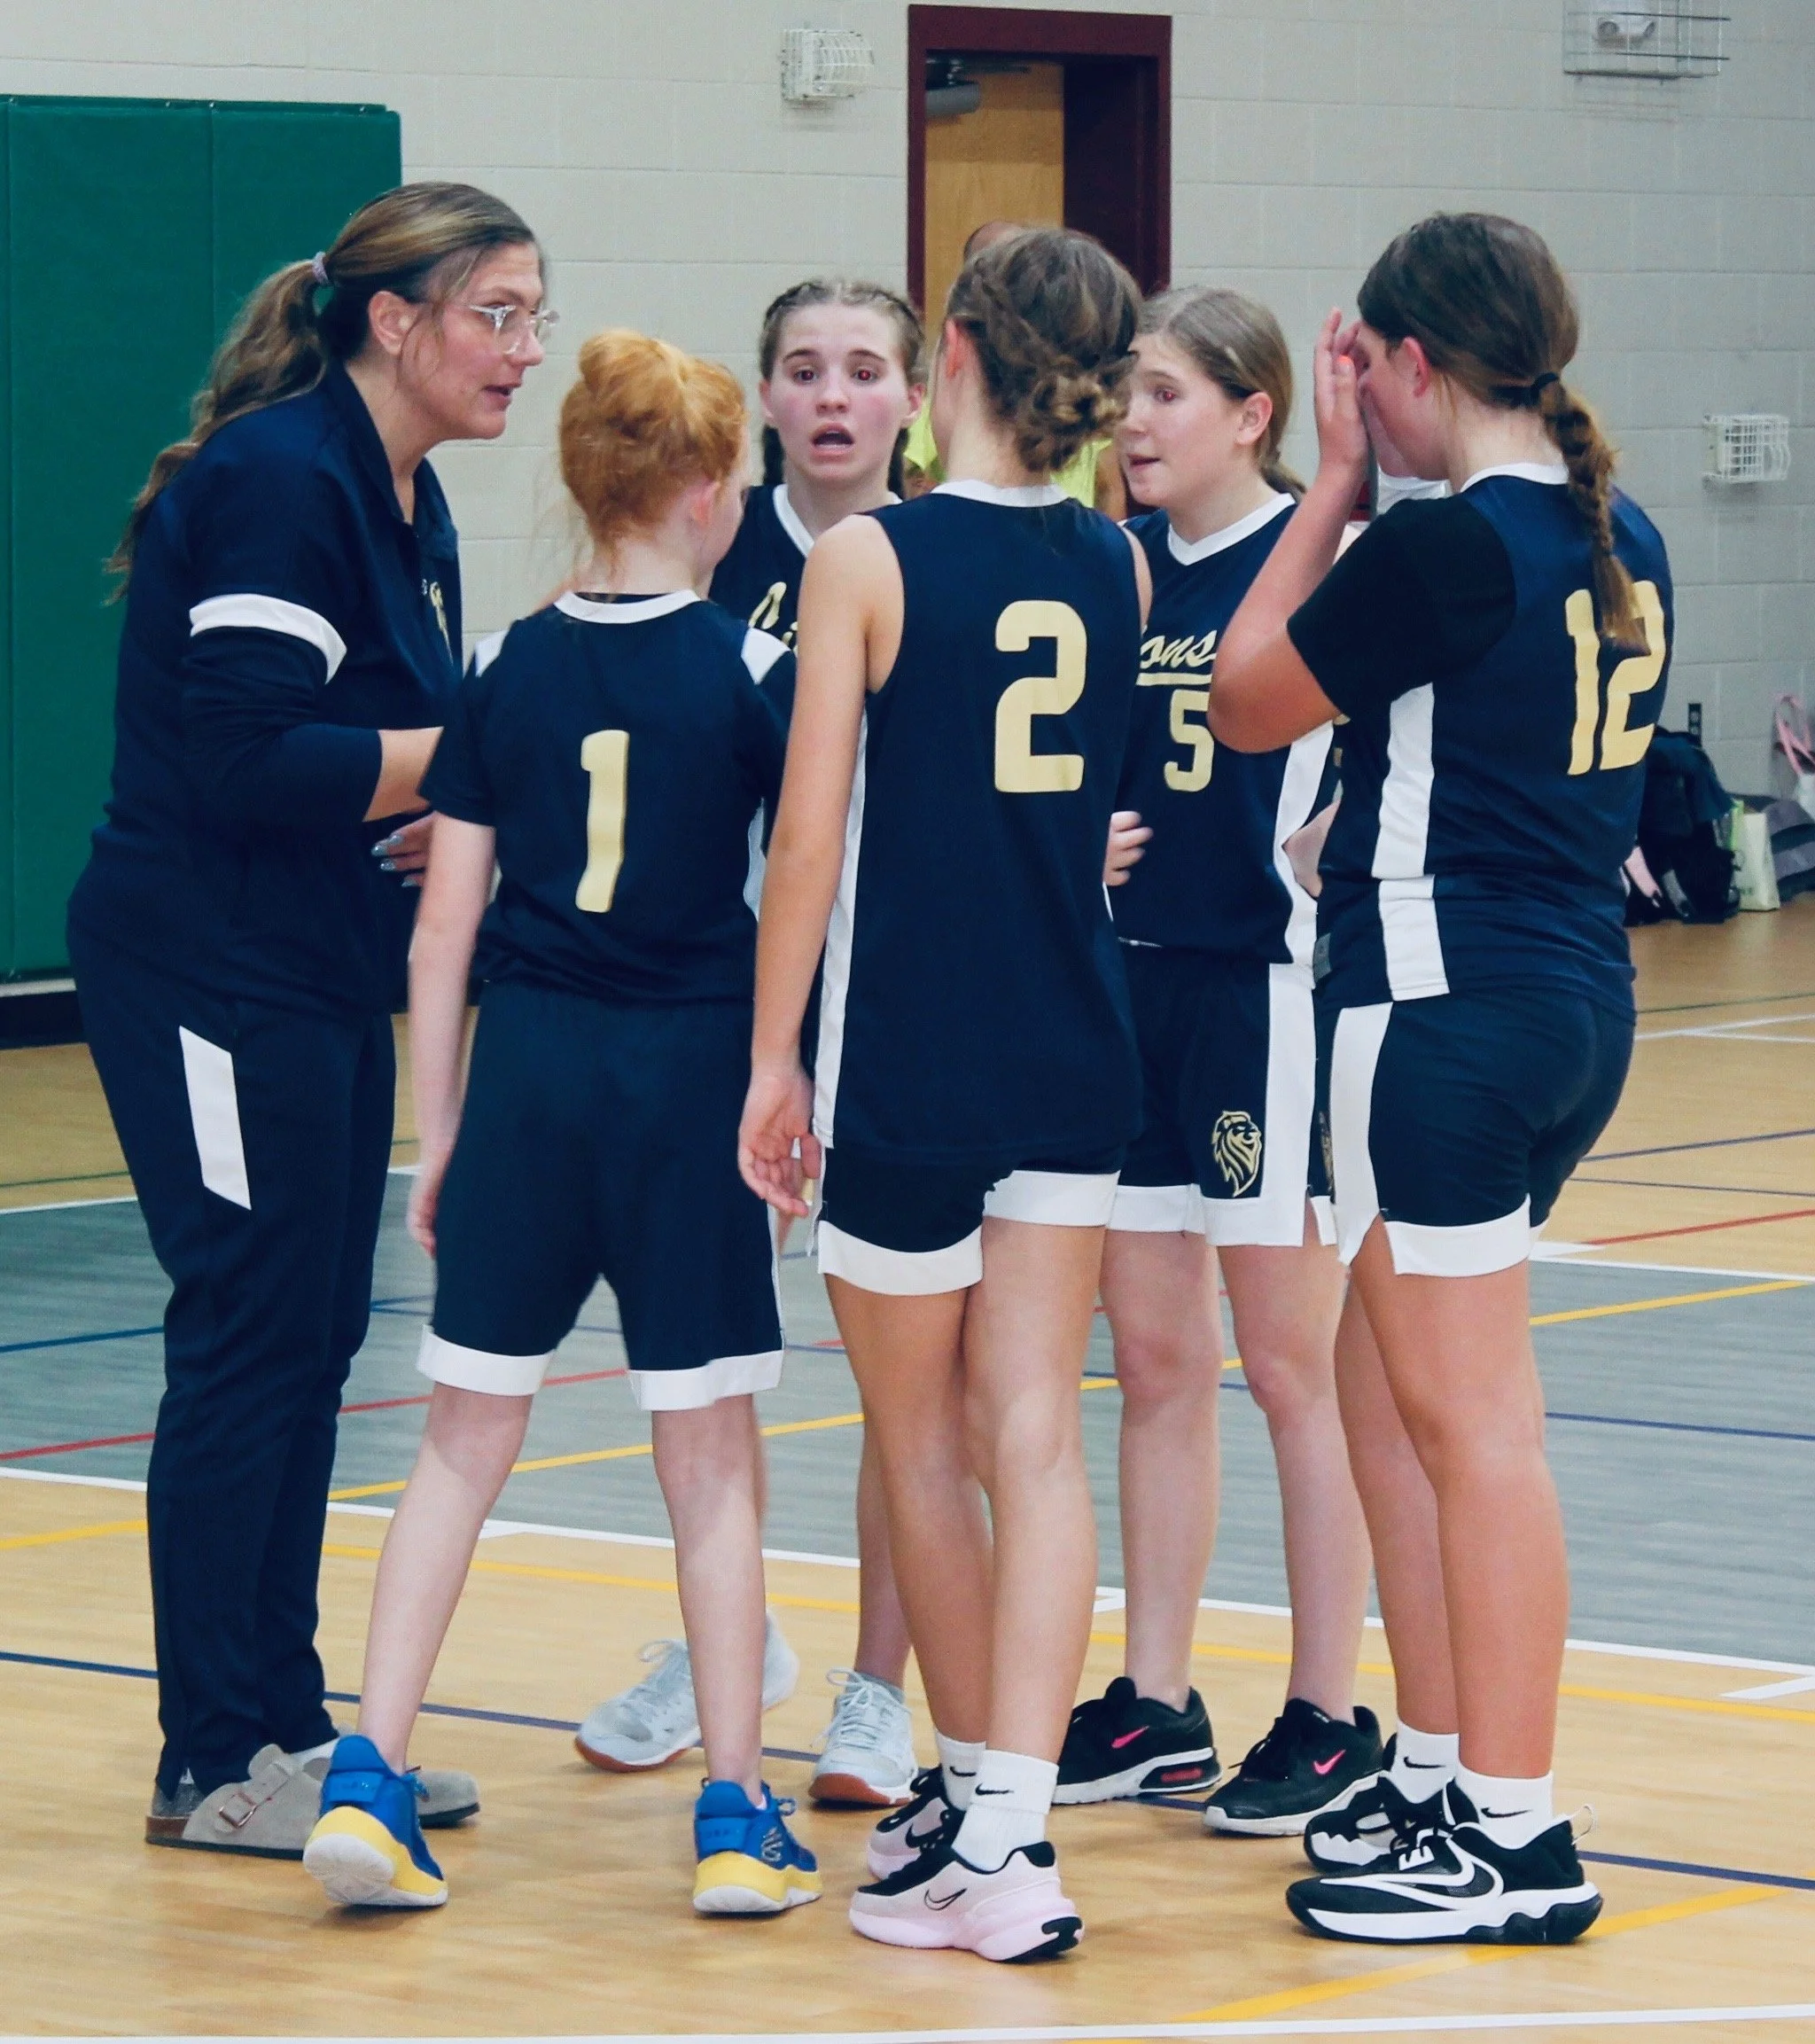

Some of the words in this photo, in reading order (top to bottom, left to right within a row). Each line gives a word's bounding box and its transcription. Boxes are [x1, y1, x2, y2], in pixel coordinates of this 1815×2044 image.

[995, 600, 1087, 792] 2
[1163, 689, 1214, 792] 5
[1565, 580, 1666, 776] 12
[575, 729, 629, 912] 1
